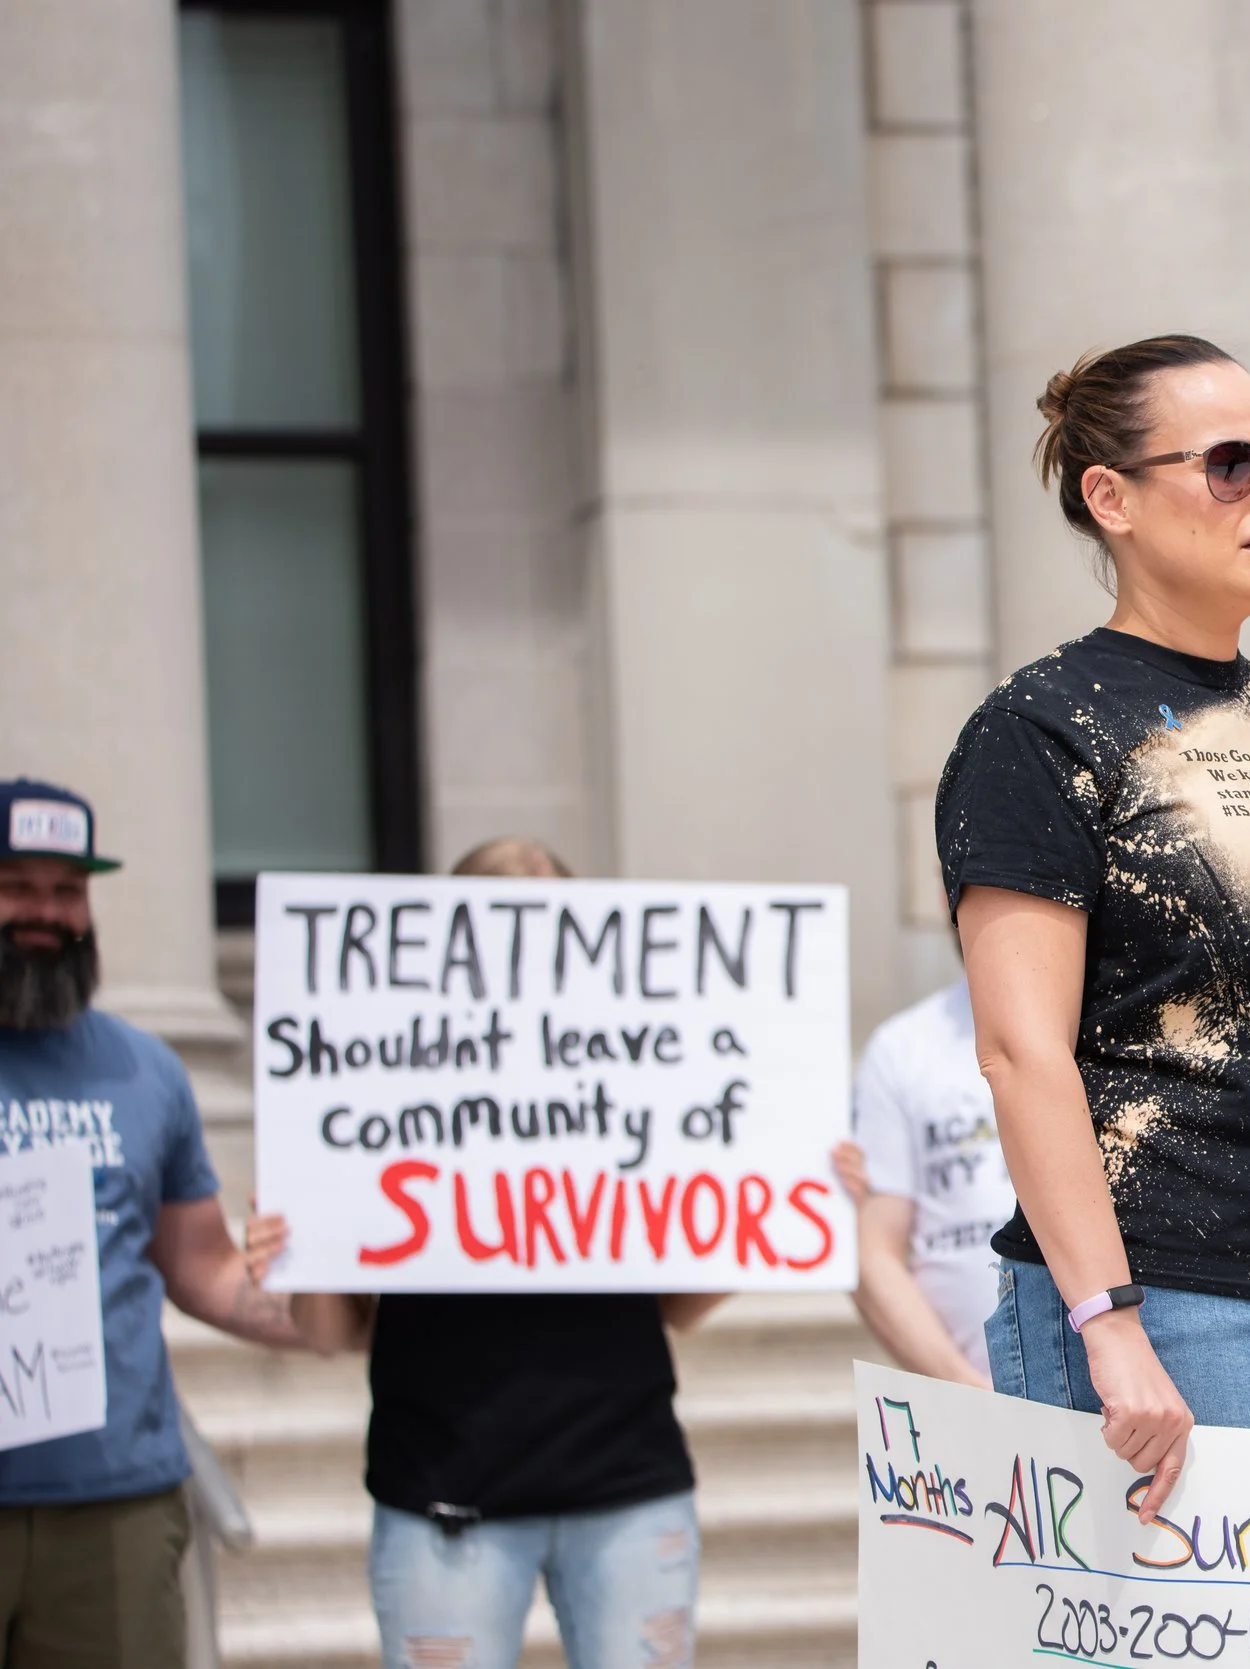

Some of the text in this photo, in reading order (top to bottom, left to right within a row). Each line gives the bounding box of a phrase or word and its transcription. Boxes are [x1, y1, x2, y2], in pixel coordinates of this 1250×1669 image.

[1179, 749, 1229, 763] Those
[1207, 769, 1238, 782] We
[285, 901, 824, 1000] TREATMENT
[267, 1009, 749, 1078] Shouldn't leave a
[321, 1079, 750, 1170] community of
[358, 1158, 835, 1271] SURVIVORS
[875, 1395, 921, 1463] 17
[866, 1452, 974, 1518] Months
[984, 1453, 1093, 1573] AIR
